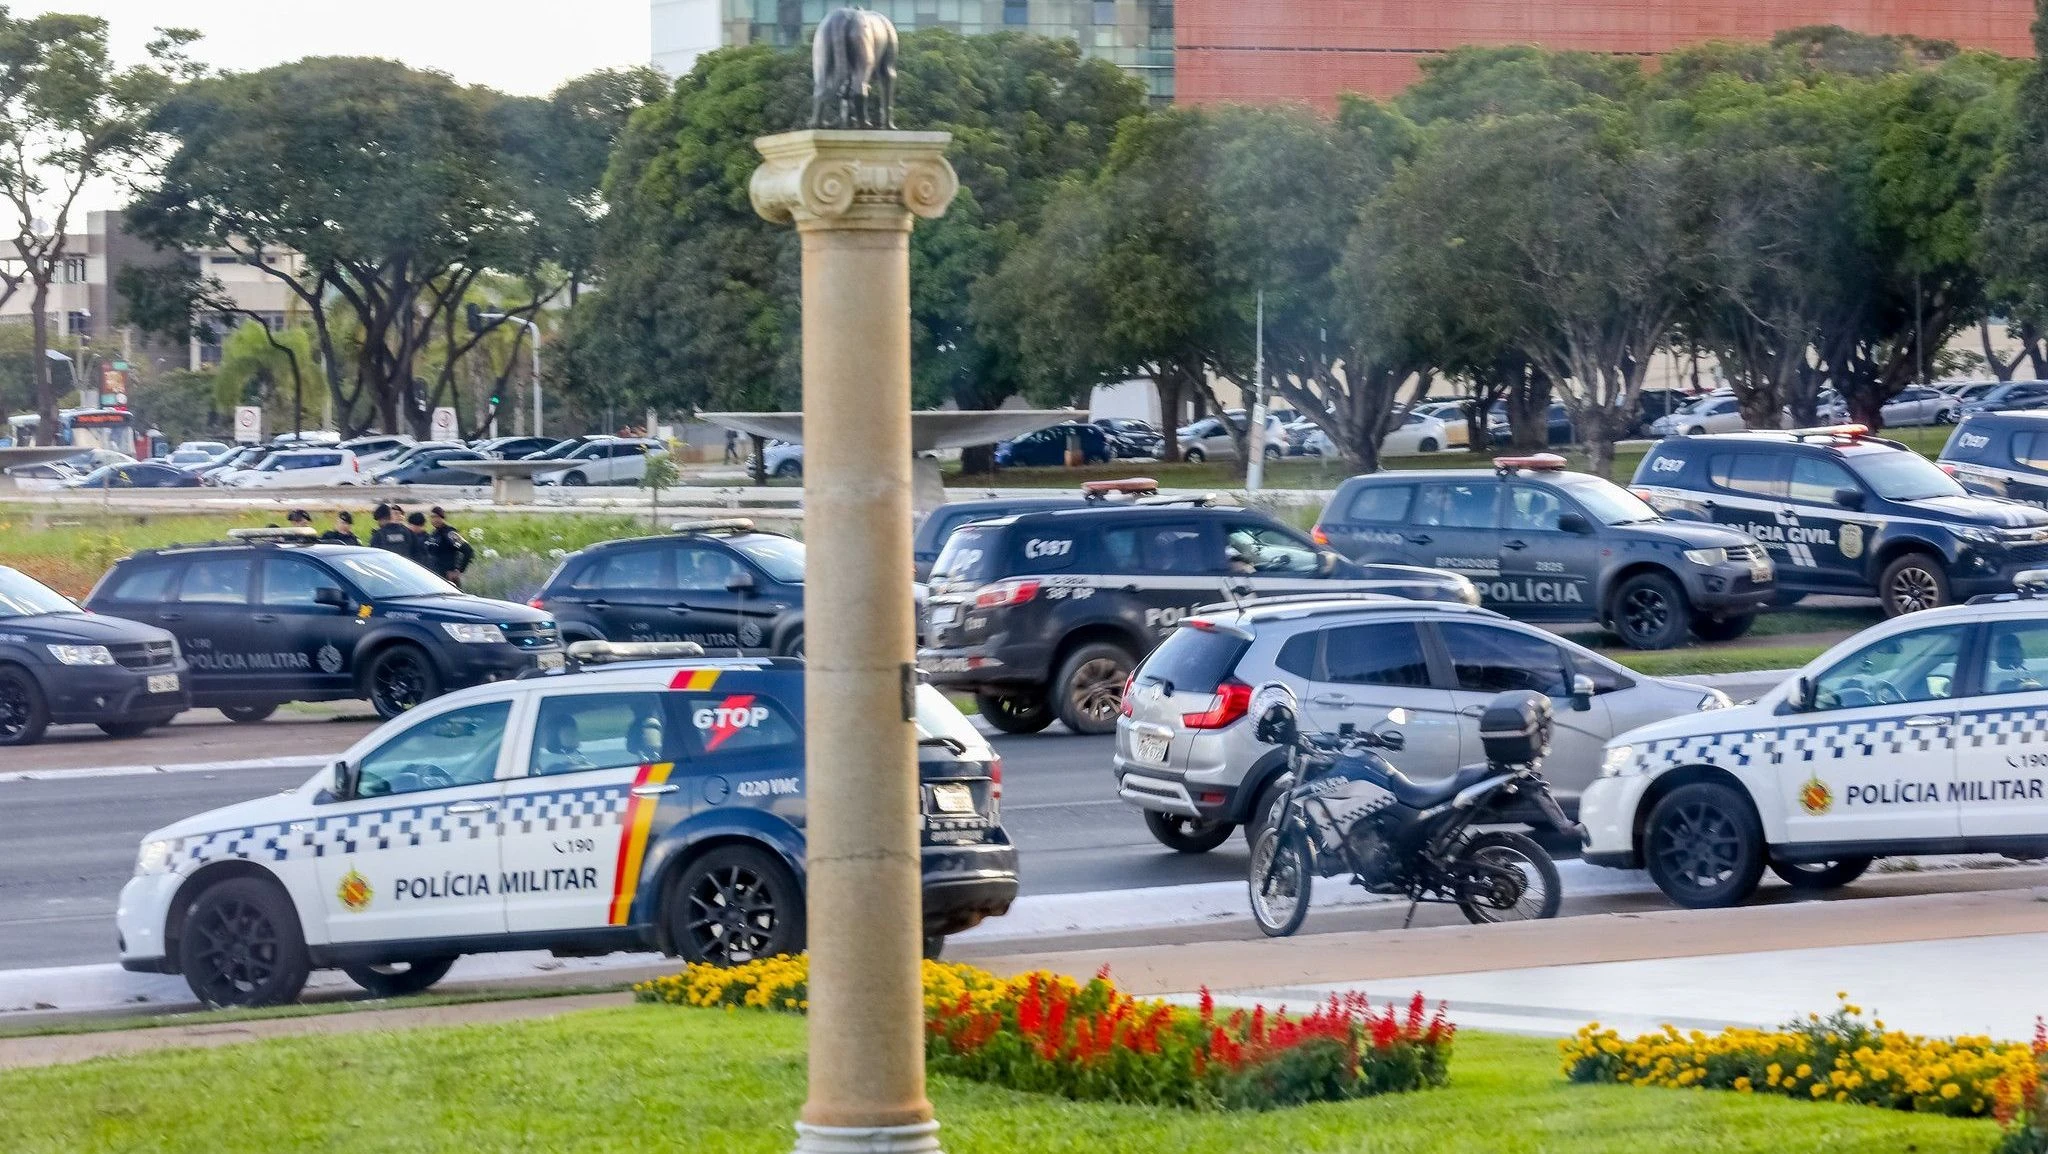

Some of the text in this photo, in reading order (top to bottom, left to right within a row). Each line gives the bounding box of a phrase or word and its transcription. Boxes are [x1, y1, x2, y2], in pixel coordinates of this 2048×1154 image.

[1719, 521, 1836, 545] LÍCIA CIVIL
[1435, 556, 1500, 569] BPCHOQUE
[1474, 578, 1583, 603] POLÍCIA
[1143, 602, 1201, 628] POLÍ
[186, 650, 312, 669] POLÍCIA MILITAR
[692, 706, 770, 729] GTOP
[2020, 752, 2048, 768] 190
[1846, 778, 2044, 806] POLÍCIA MILITAR
[567, 837, 595, 853] 190
[394, 866, 598, 901] POLÍCIA MILITAR
